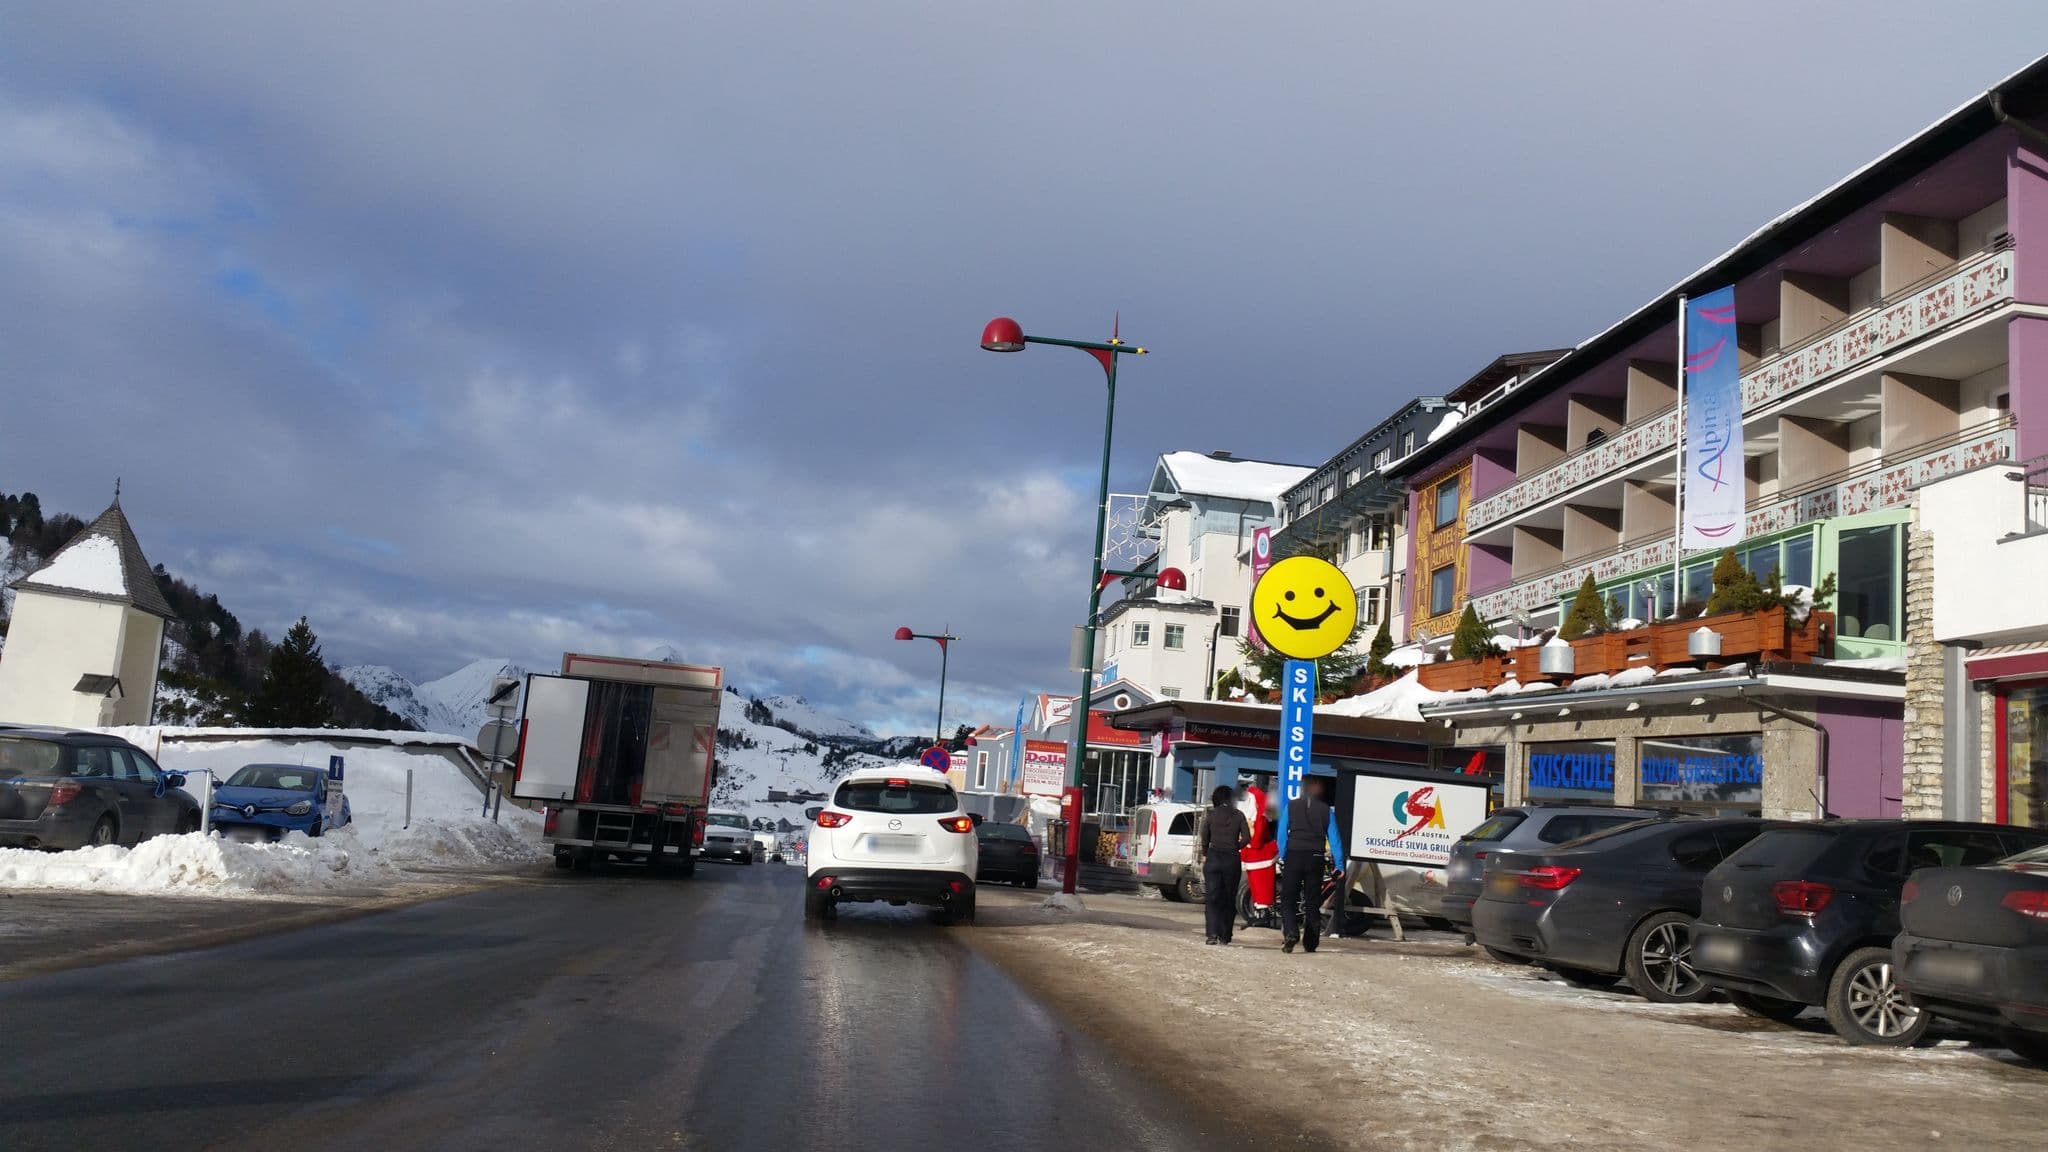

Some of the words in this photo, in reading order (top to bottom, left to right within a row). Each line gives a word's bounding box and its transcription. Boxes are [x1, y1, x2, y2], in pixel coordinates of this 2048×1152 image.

[1432, 528, 1455, 548] HOTEL
[1431, 546, 1455, 566] ALPINA
[1287, 668, 1308, 801] SKISCHU
[1027, 752, 1066, 765] Dolls
[1529, 753, 1615, 790] SKISCHULE
[1641, 757, 1679, 784] SILVIA
[1365, 837, 1404, 849] SKISCHULE
[1405, 841, 1428, 851] SILVIA
[1421, 831, 1450, 839] AUSTRIA
[1369, 847, 1409, 857] Obertauerns
